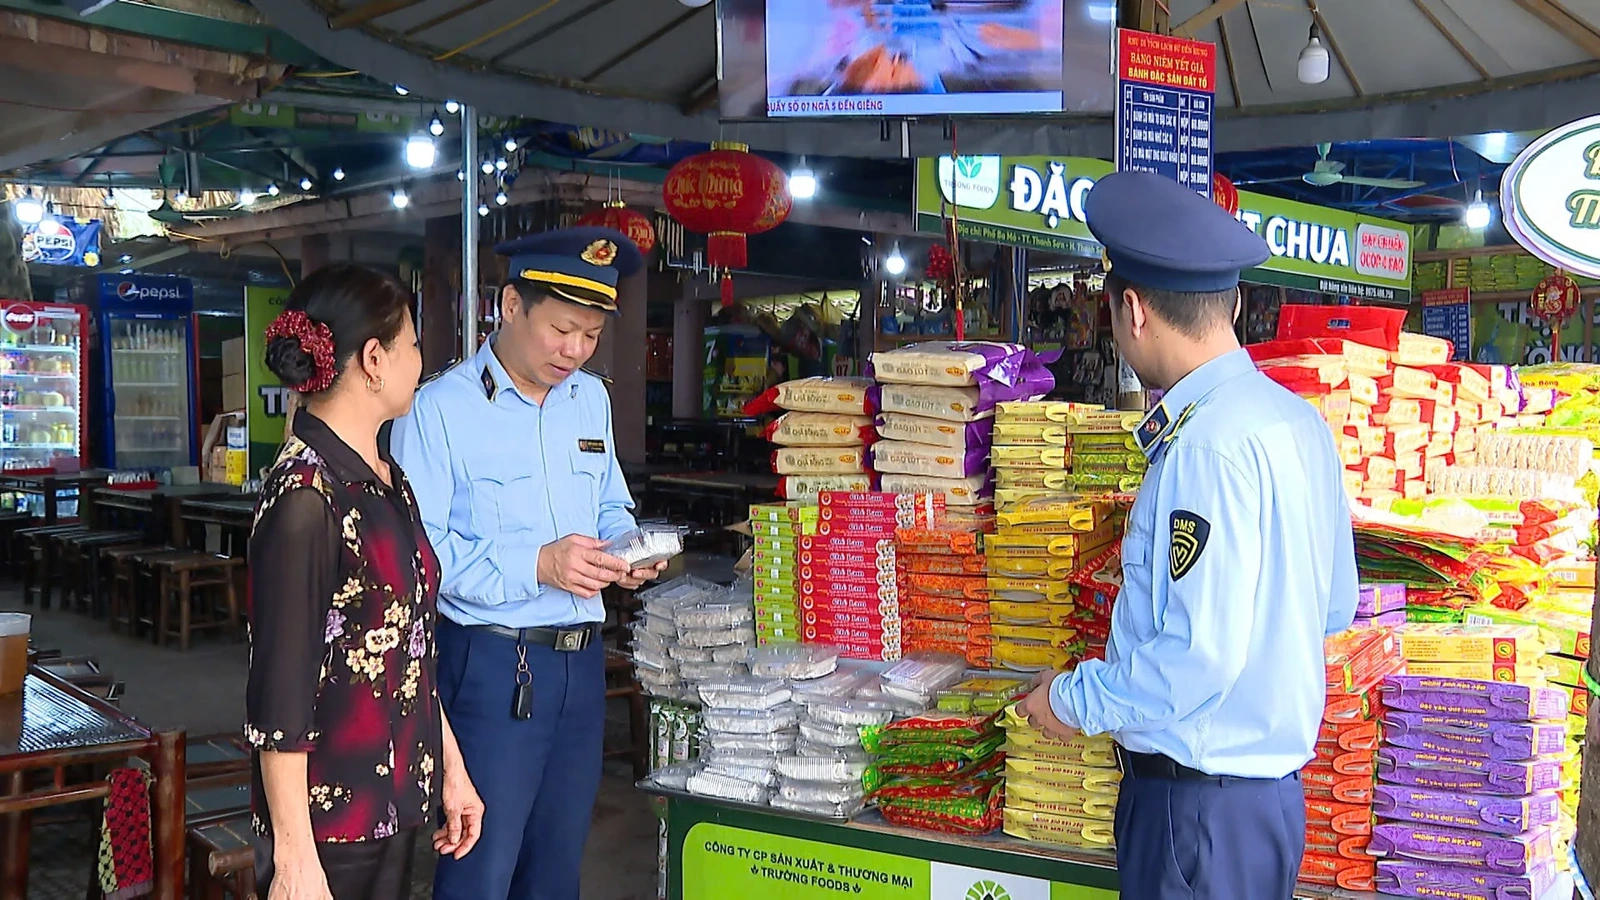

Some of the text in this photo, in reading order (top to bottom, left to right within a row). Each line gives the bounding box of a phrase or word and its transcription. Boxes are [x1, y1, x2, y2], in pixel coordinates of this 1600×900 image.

[1190, 60, 1204, 74] GIÁ
[1128, 66, 1148, 80] BÁNH
[1150, 70, 1164, 84] ĐẶC
[1167, 71, 1181, 84] SẢN
[768, 100, 786, 112] UẦY
[801, 102, 810, 112] 07
[36, 236, 72, 248] PEPSI
[1360, 253, 1380, 269] OCOP
[1388, 258, 1404, 274] SAO
[140, 286, 180, 300] pepsi
[866, 494, 883, 502] Lam
[1174, 518, 1196, 534] DMS
[847, 554, 864, 562] Lam
[848, 585, 866, 593] Lam
[849, 600, 866, 608] Lam
[851, 615, 869, 623] Lam
[704, 840, 913, 890] CÔNG TY CP SẢN XUẤT & THƯƠNG MẠI
[761, 866, 850, 892] TRƯỜNG FOODS
